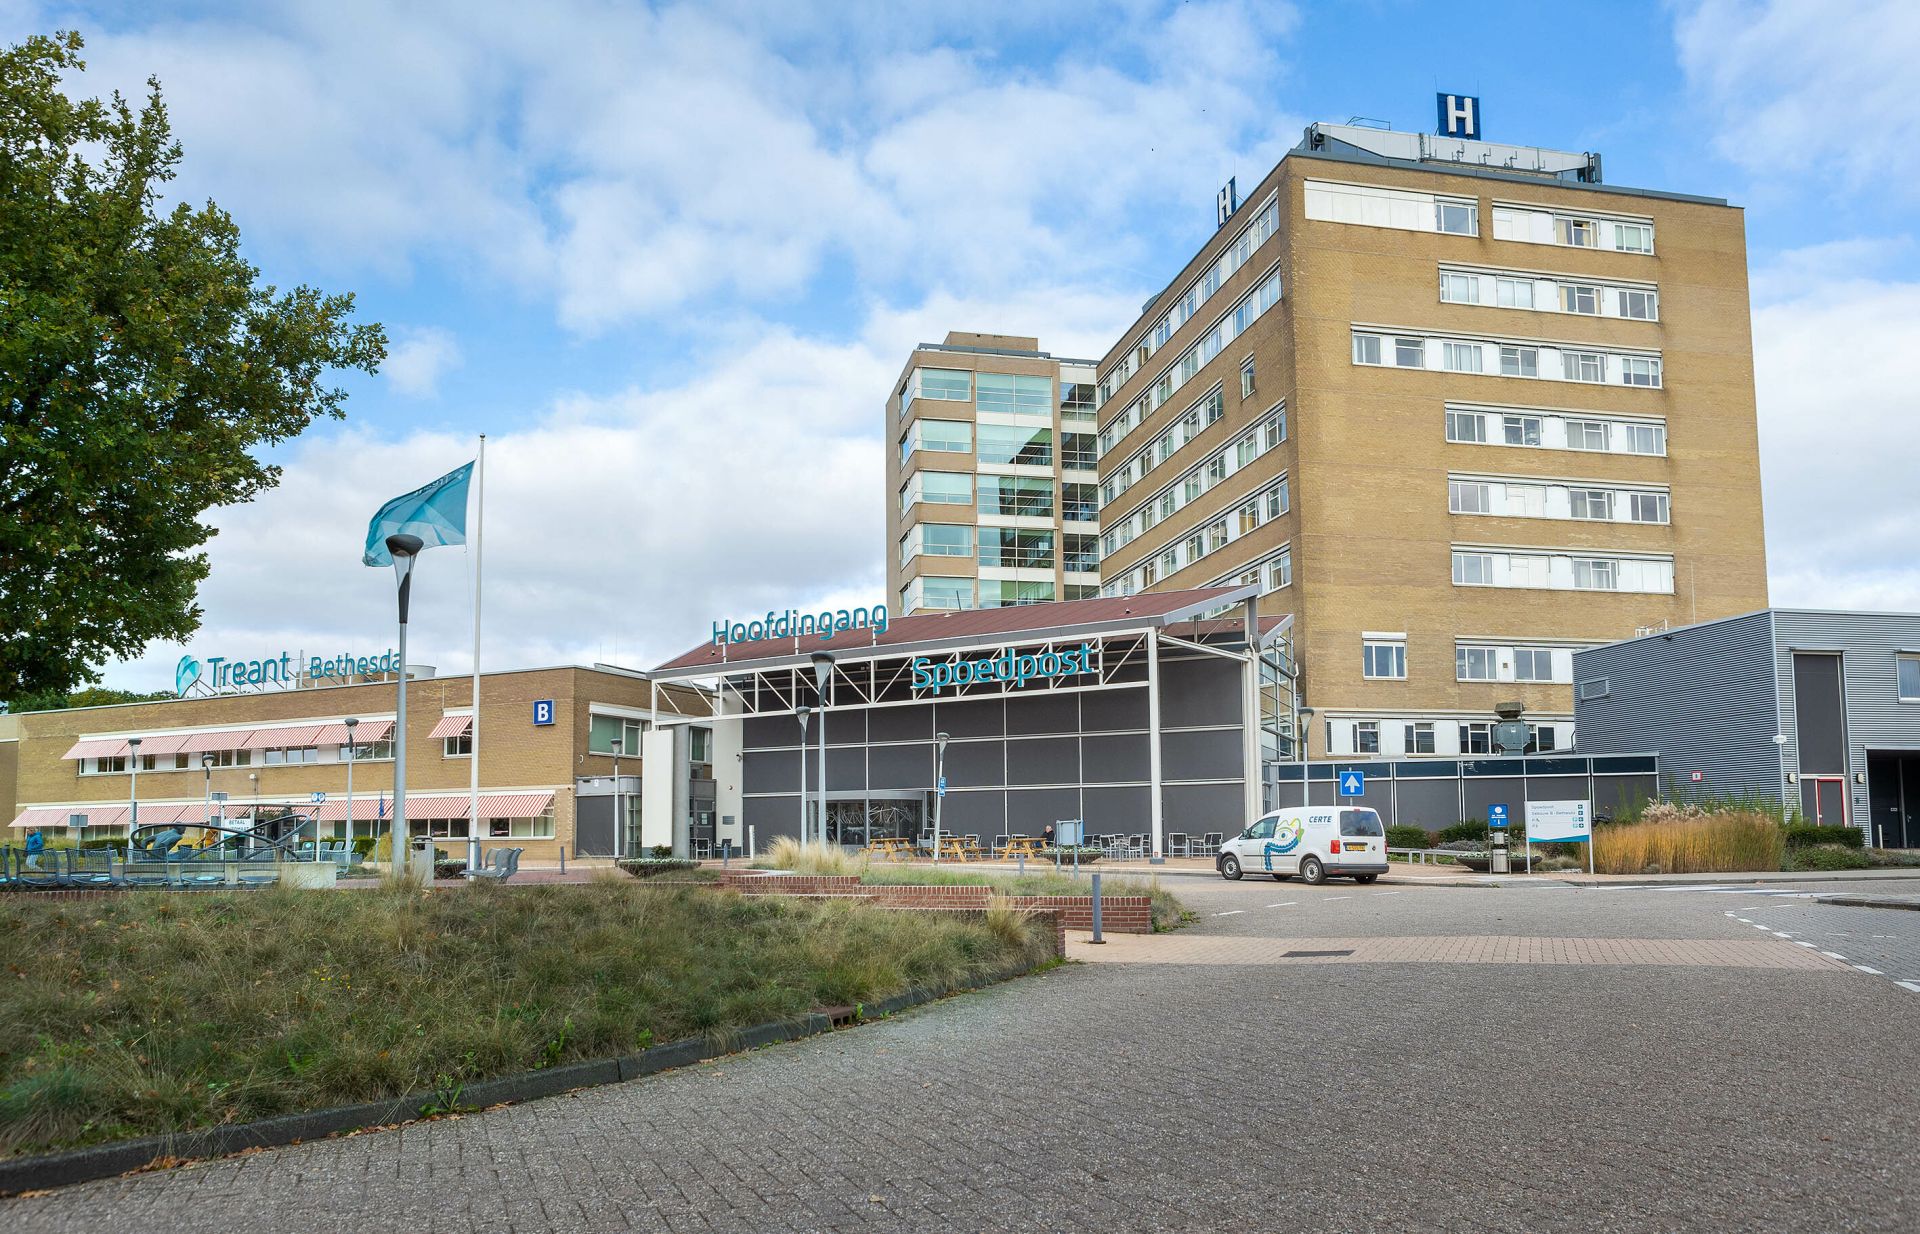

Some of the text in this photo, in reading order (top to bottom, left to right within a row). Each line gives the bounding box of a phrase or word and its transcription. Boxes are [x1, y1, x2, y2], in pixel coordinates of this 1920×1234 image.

[1447, 95, 1474, 135] H
[1218, 183, 1231, 225] H
[713, 604, 888, 646] Hoofdingang
[207, 648, 400, 687] Treant Bethesda
[912, 642, 1094, 694] Spoedpost
[537, 703, 549, 722] B
[1308, 815, 1333, 824] CERTE
